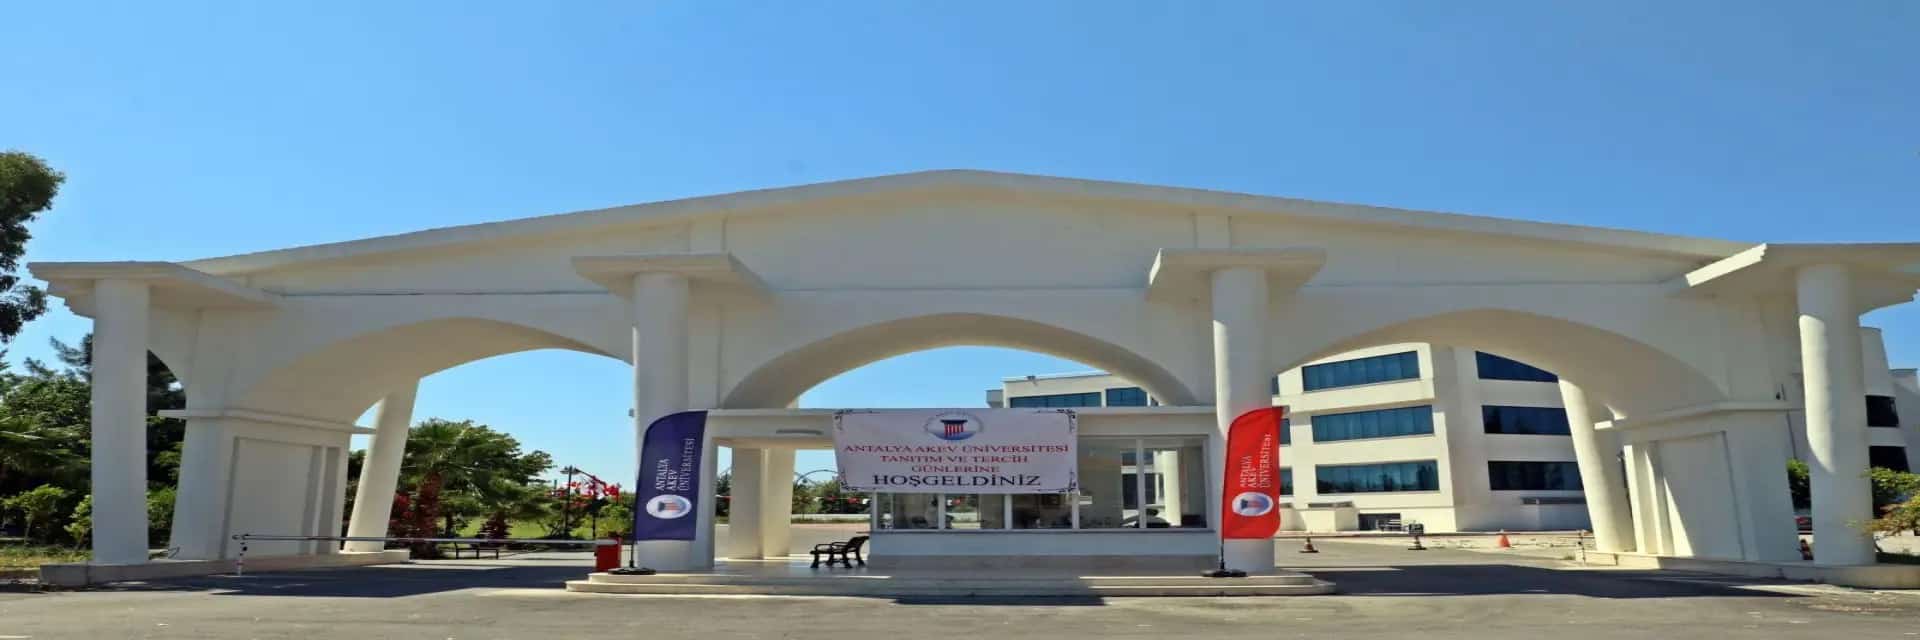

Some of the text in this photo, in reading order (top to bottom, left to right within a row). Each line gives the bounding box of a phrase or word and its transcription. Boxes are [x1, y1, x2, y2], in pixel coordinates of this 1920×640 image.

[843, 444, 912, 454] ANTALYA
[915, 444, 957, 454] AKEV
[880, 454, 1028, 463] TANITIM VE TERCİH
[655, 458, 671, 491] ANTALYA
[911, 464, 1000, 473] GÜNLERİNE
[1240, 455, 1252, 488] ANTALYA
[1247, 466, 1257, 488] AKEV
[666, 469, 678, 491] AKEV
[873, 473, 1041, 487] HOŞGELDİNİZ
